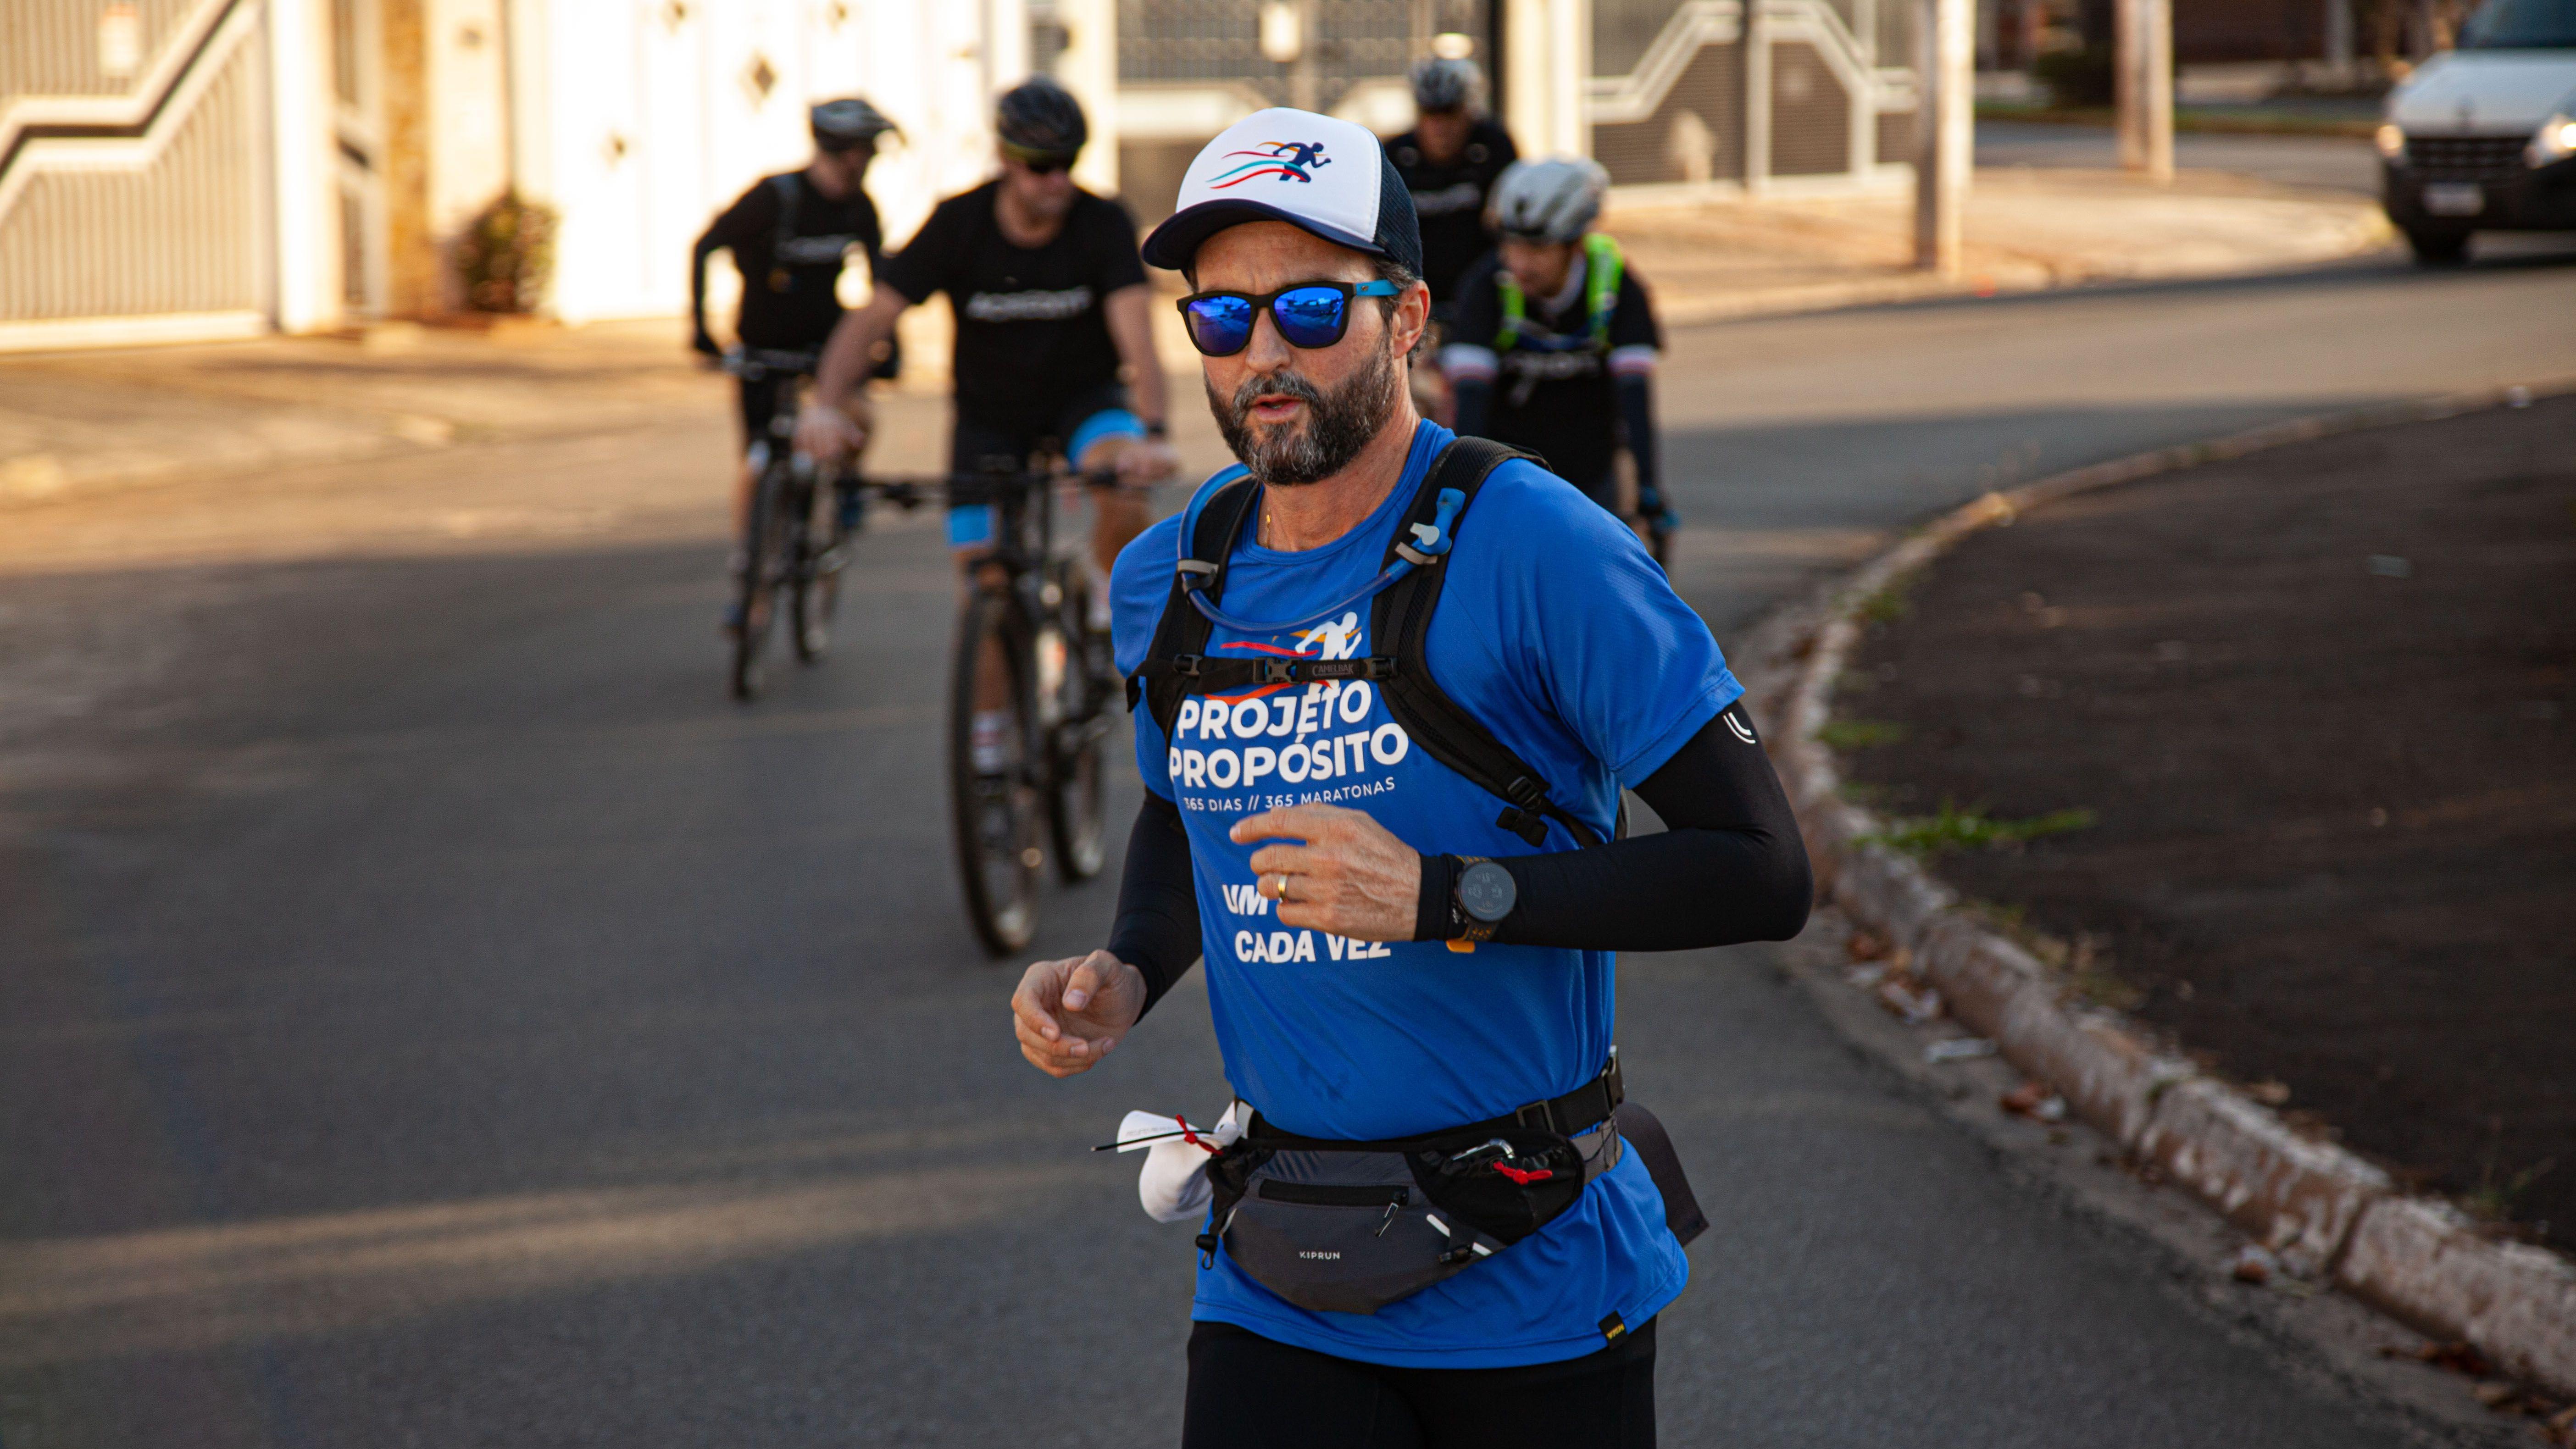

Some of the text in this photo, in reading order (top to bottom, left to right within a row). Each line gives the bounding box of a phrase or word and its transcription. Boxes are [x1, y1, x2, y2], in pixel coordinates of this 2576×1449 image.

[1312, 665, 1354, 676] CAMELBAK
[1177, 680, 1372, 740] PROJETO
[1169, 723, 1409, 788] PROPÓSITO
[1209, 798, 1243, 811] DIAS
[1265, 794, 1293, 809] 365
[1301, 777, 1395, 805] MARATONAS
[1222, 884, 1268, 916] UM
[1235, 930, 1391, 963] CADA VEZ
[1299, 1251, 1340, 1260] KIPRUN
